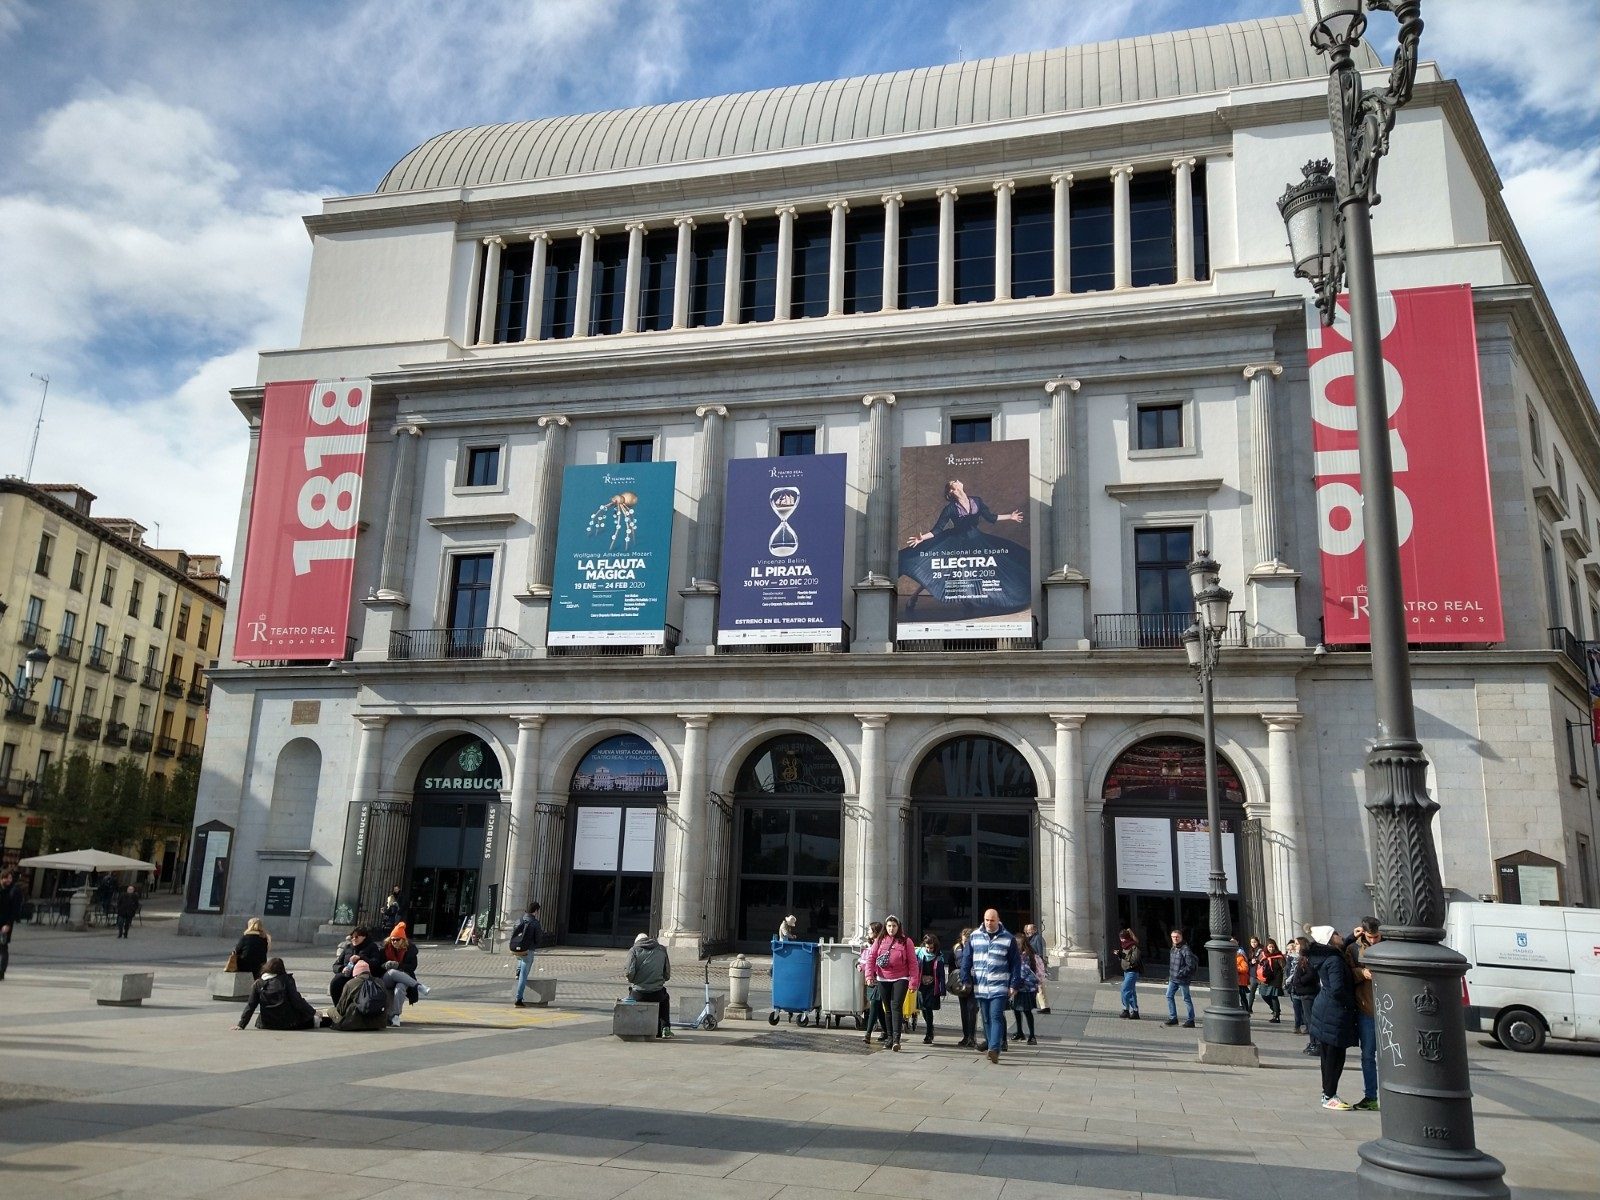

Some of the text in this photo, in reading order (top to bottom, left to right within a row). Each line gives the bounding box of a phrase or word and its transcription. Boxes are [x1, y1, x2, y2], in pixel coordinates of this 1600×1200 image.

[293, 380, 371, 576] 1818
[577, 559, 646, 570] LA FLAUTA
[931, 556, 997, 569] ELECTRA
[585, 567, 635, 580] MÁGICA
[750, 565, 812, 577] IL PIRATA
[932, 571, 942, 579] 28
[574, 582, 582, 590] 19
[1444, 600, 1483, 611] REAL
[270, 626, 307, 635] TEATRO
[311, 626, 335, 634] REAL
[425, 778, 503, 790] STARBUCK
[356, 806, 368, 856] STARBUCKS
[484, 808, 496, 859] STARBUCKS
